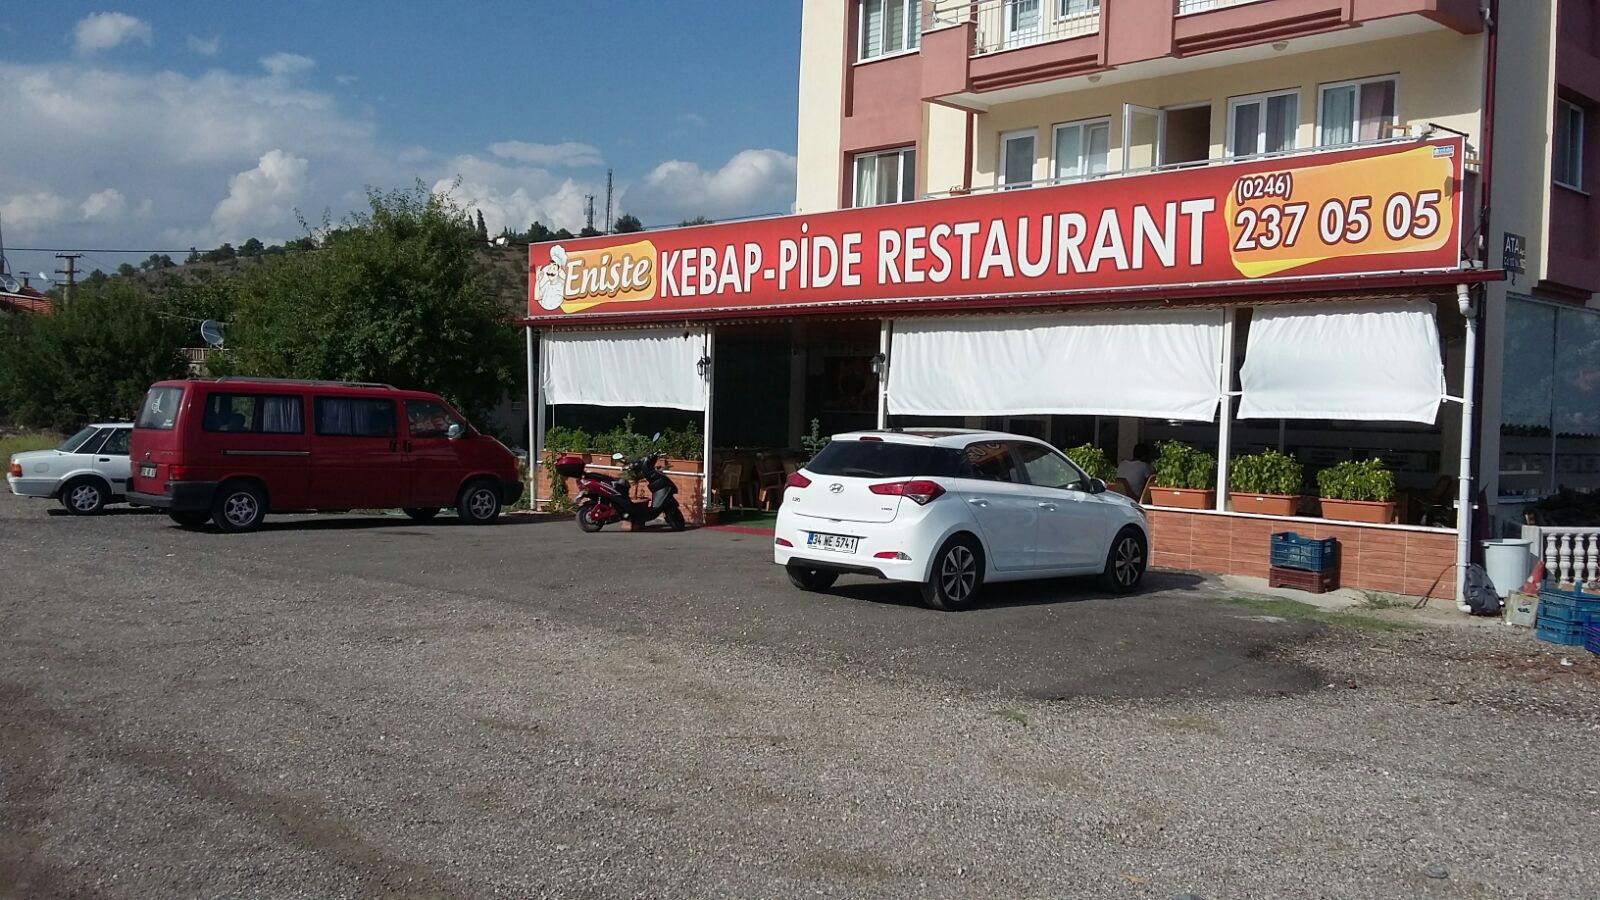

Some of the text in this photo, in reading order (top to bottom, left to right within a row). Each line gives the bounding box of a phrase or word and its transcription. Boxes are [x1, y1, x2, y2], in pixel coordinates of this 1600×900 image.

[1237, 175, 1292, 203] (0246)
[1234, 191, 1440, 250] 237 05 05
[660, 198, 1215, 298] KEBAP-PİDE RESTAURANT
[1505, 236, 1520, 254] ATA
[564, 253, 651, 297] Enişte
[812, 534, 822, 545] 34
[835, 537, 855, 550] 5741
